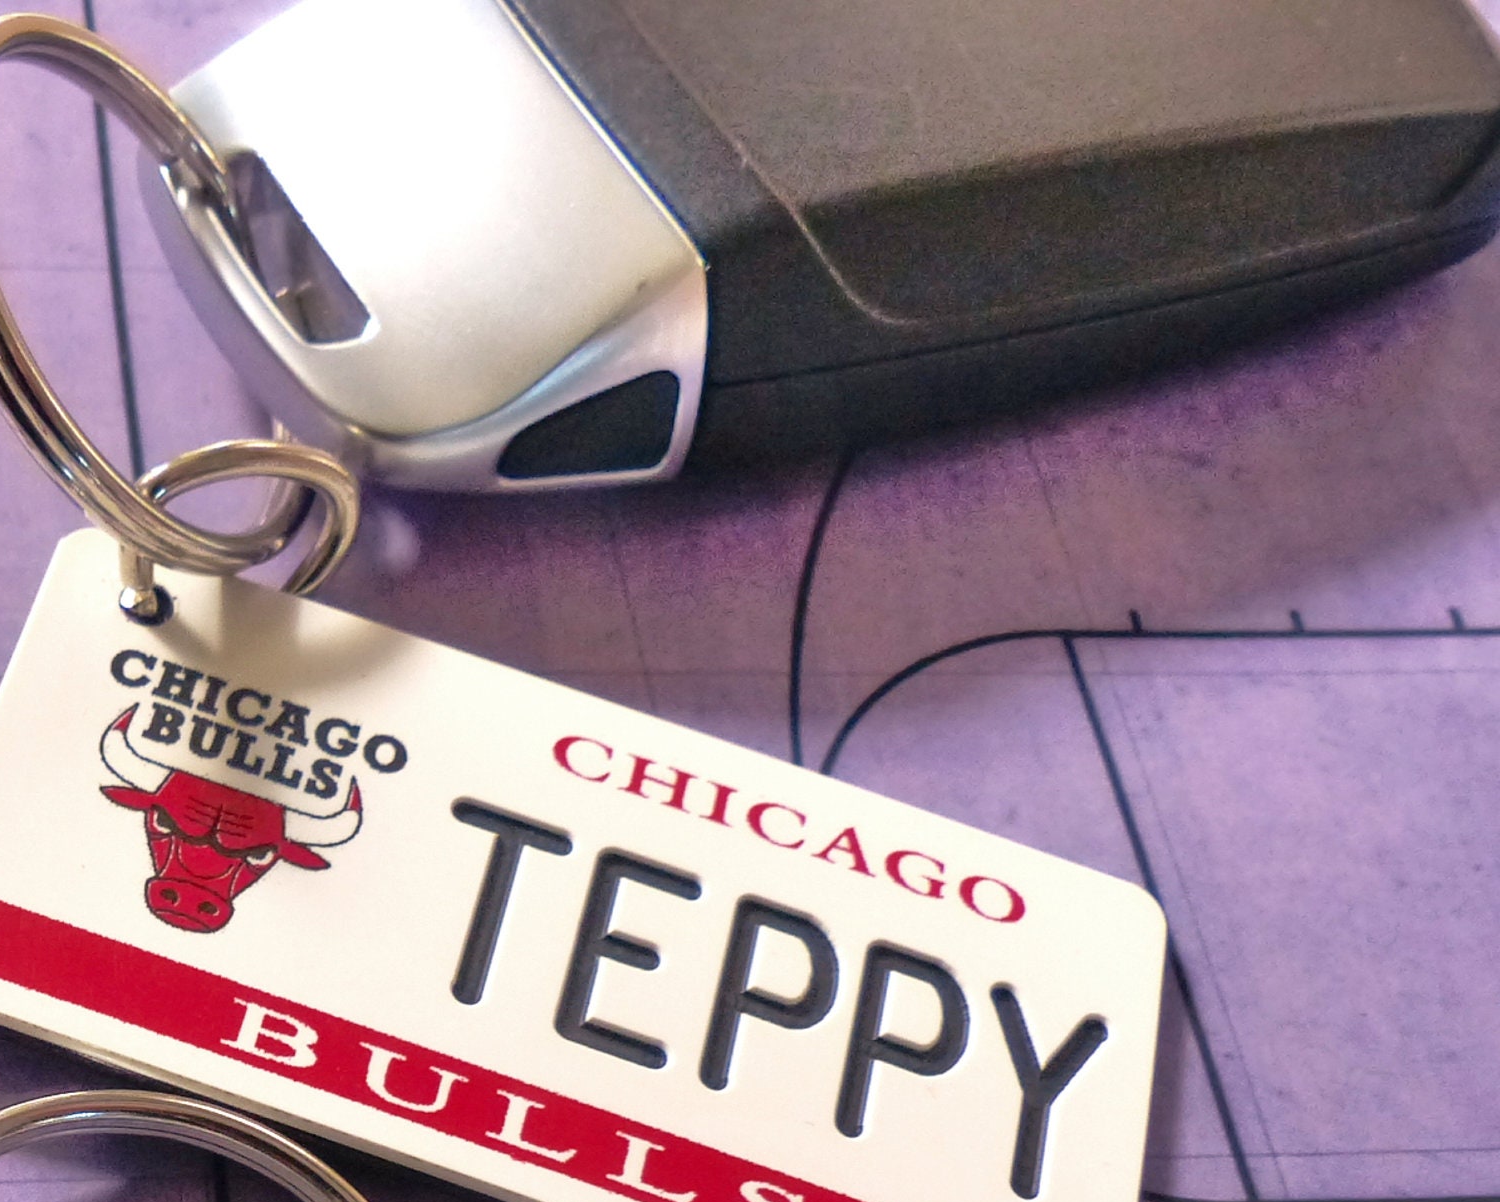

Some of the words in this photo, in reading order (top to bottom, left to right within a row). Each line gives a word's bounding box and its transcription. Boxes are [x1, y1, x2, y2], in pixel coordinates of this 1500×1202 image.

[110, 649, 409, 779] CHICAGO
[142, 701, 341, 801] BULLS
[552, 733, 1027, 925] CHICAGO
[450, 795, 1109, 1200] TEPPY
